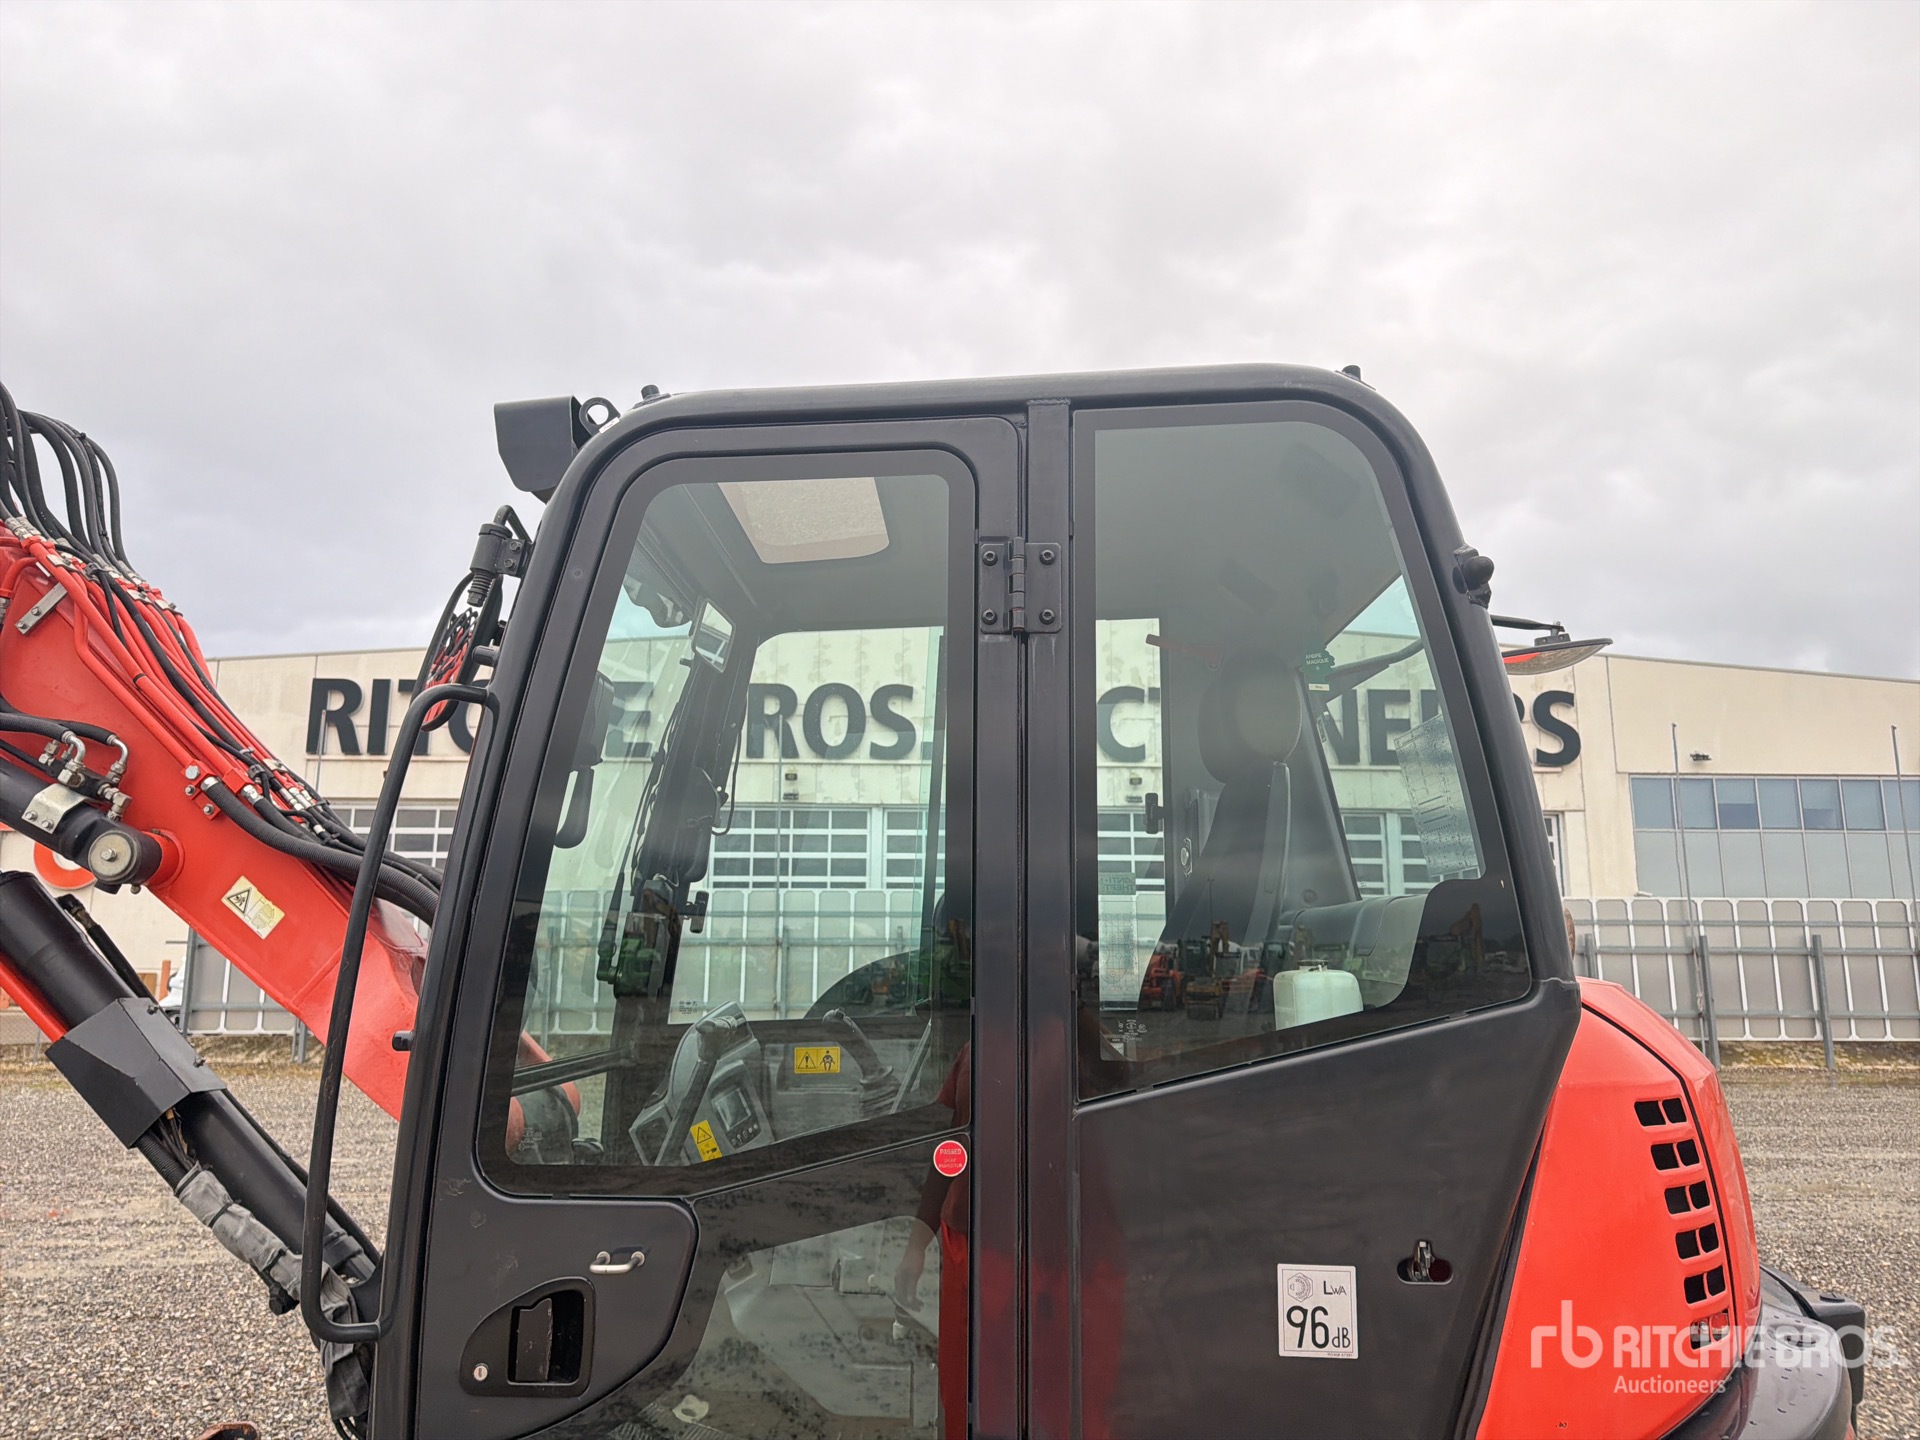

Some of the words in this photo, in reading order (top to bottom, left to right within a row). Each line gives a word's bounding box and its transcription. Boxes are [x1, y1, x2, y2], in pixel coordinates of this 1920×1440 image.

[306, 678, 654, 757] RICE
[1286, 1305, 1330, 1349] 96
[1331, 1326, 1351, 1348] dB
